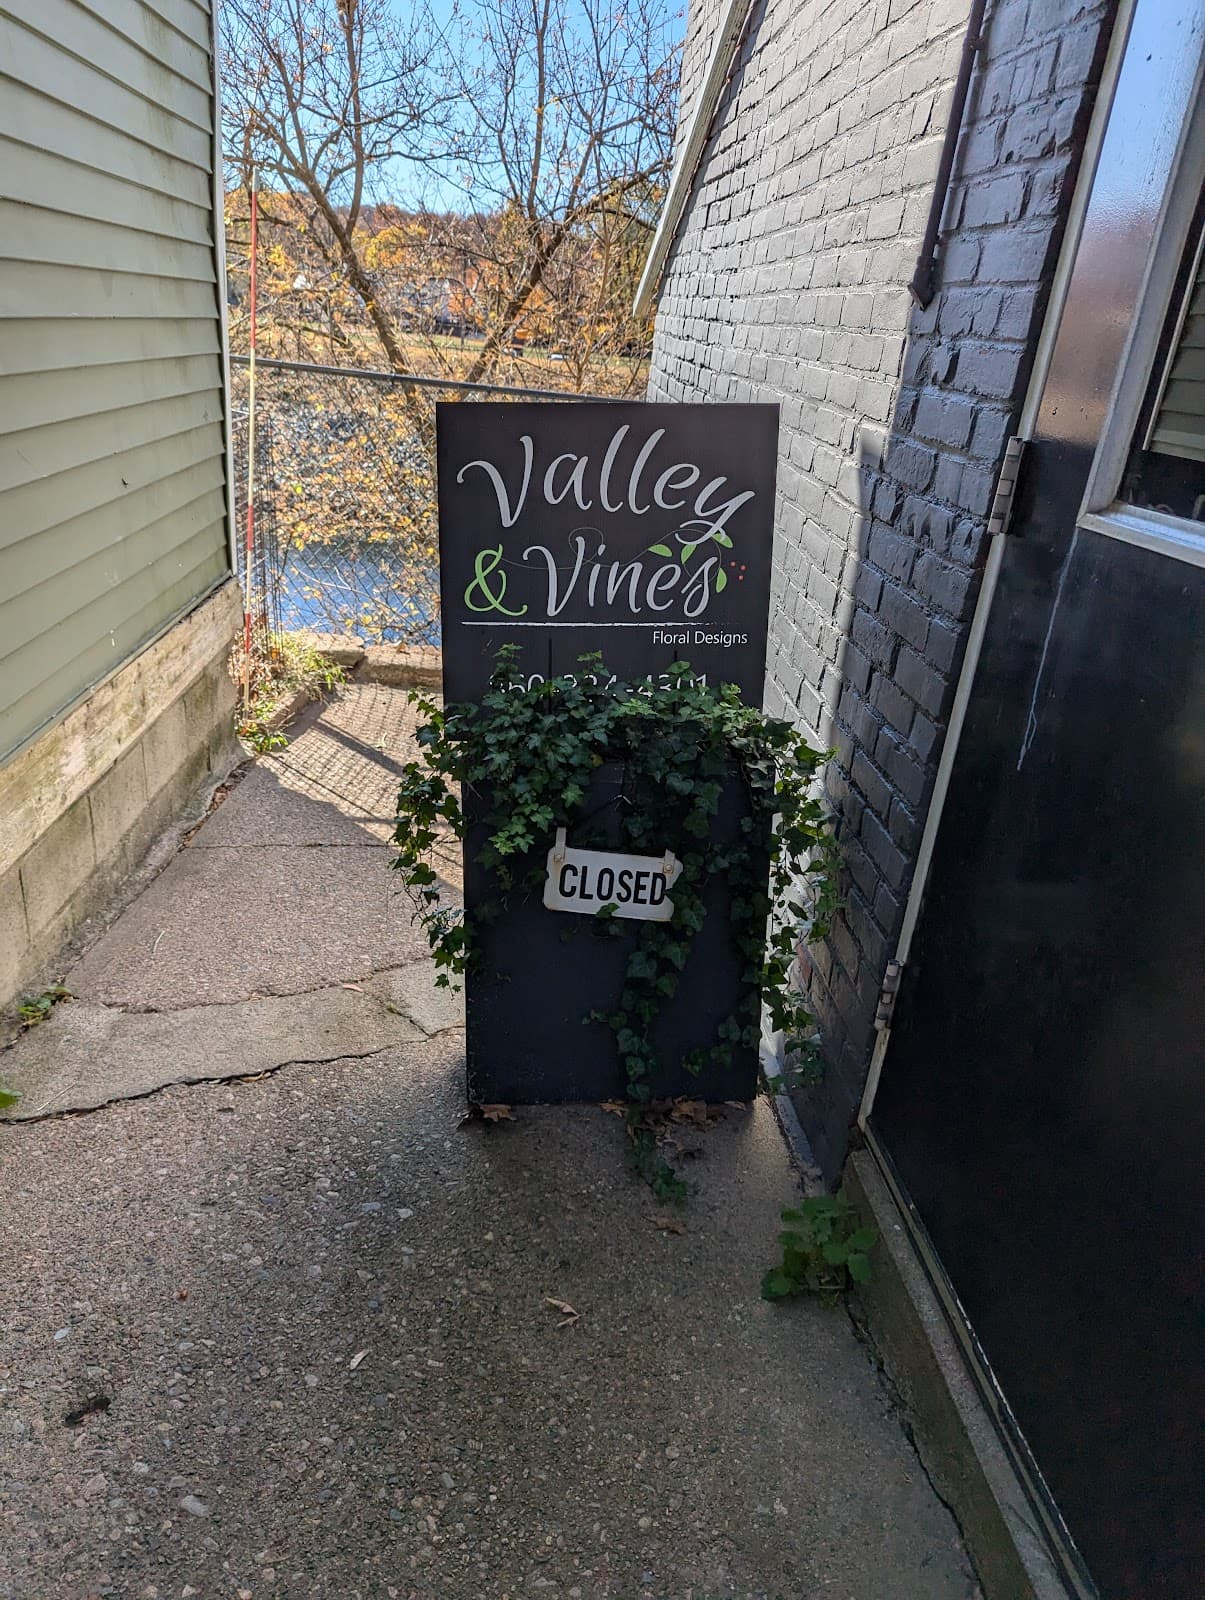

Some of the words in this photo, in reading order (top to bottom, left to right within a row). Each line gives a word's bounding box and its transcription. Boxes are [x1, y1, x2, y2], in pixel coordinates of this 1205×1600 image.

[456, 424, 755, 545] Valley
[464, 543, 528, 617] &
[523, 536, 718, 618] Vines
[652, 630, 690, 645] Floral
[694, 630, 748, 648] Designs
[558, 863, 667, 906] CLOSED
